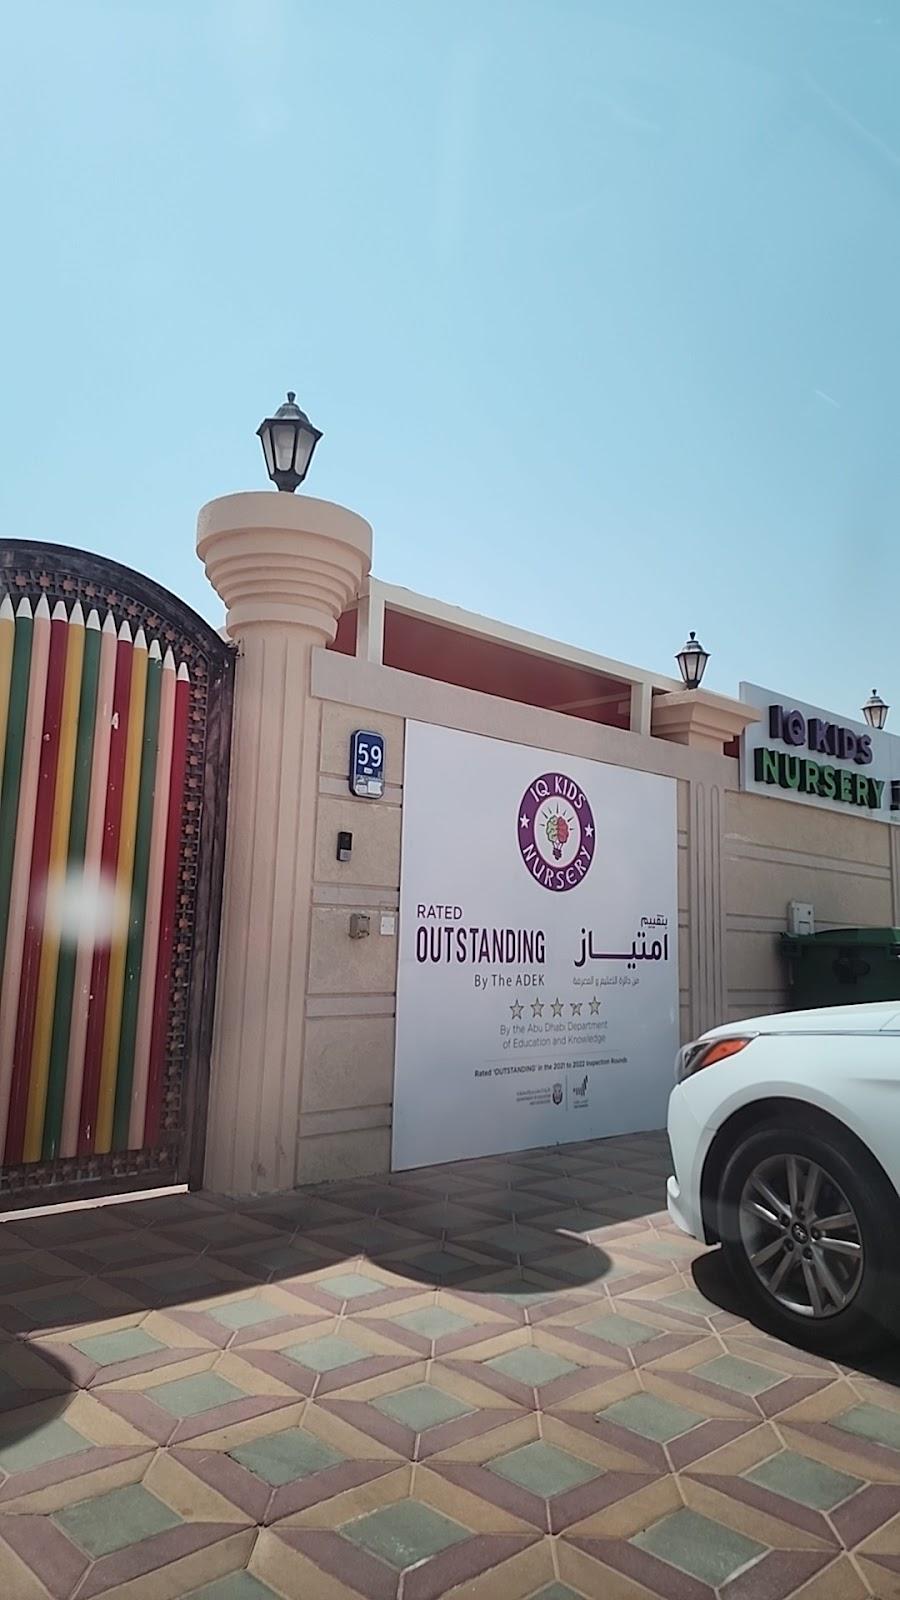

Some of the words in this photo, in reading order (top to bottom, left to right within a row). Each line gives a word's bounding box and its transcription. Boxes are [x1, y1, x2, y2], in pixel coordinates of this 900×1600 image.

[769, 705, 806, 746] IQ
[808, 718, 873, 765] KIDS
[358, 742, 382, 767] 59
[530, 779, 551, 802] IQ
[554, 775, 586, 809] KIDS
[754, 747, 885, 809] NURSERY
[522, 843, 591, 889] NURSERY
[417, 904, 462, 920] RATED
[416, 926, 545, 963] OUTSTANDING
[573, 927, 668, 970] امتياز
[474, 974, 488, 990] By
[492, 974, 512, 987] The
[515, 973, 545, 987] ADEK
[500, 1024, 511, 1036] By
[513, 1024, 525, 1034] the
[527, 1023, 543, 1033] Abu
[567, 1020, 608, 1032] Department
[502, 1039, 511, 1050] of
[513, 1038, 551, 1049] Education
